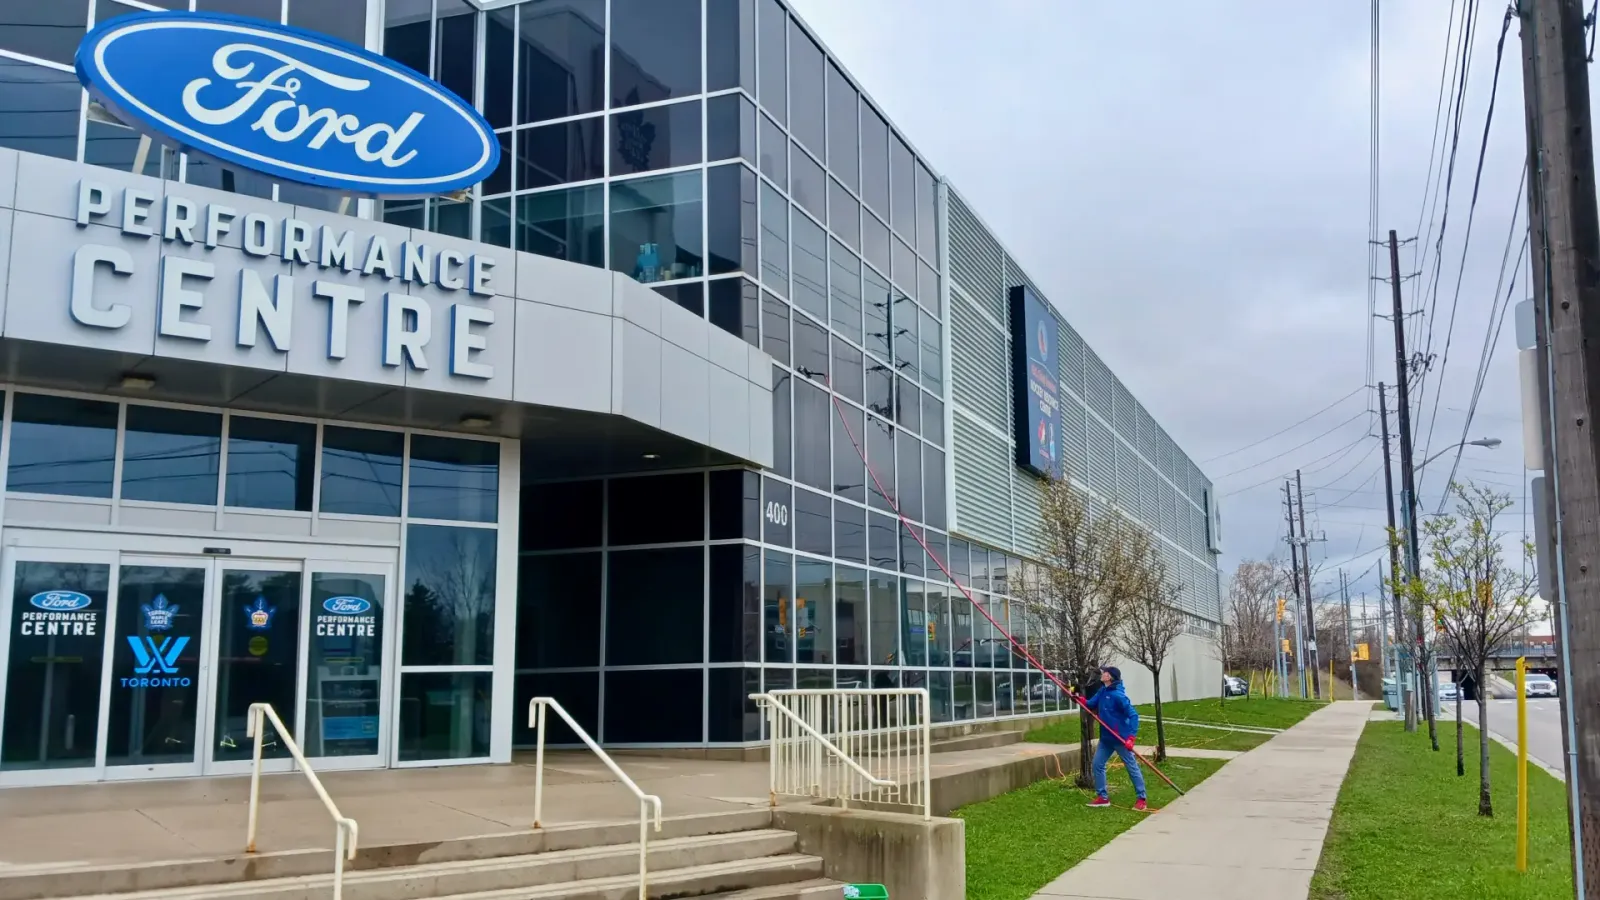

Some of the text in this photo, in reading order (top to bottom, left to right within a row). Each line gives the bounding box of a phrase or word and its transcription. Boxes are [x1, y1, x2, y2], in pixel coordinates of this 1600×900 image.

[182, 43, 425, 168] Ford
[75, 177, 496, 297] PERFORMANCE
[70, 243, 495, 380] CENTRE
[766, 501, 787, 526] 400
[42, 592, 80, 607] Ford
[332, 598, 362, 611] Ford
[22, 612, 97, 621] PERFORMANCE
[317, 615, 375, 624] PERFORMANCE
[21, 621, 97, 636] CENTRE
[316, 624, 376, 636] CENTRE
[120, 677, 191, 688] TORONTO
